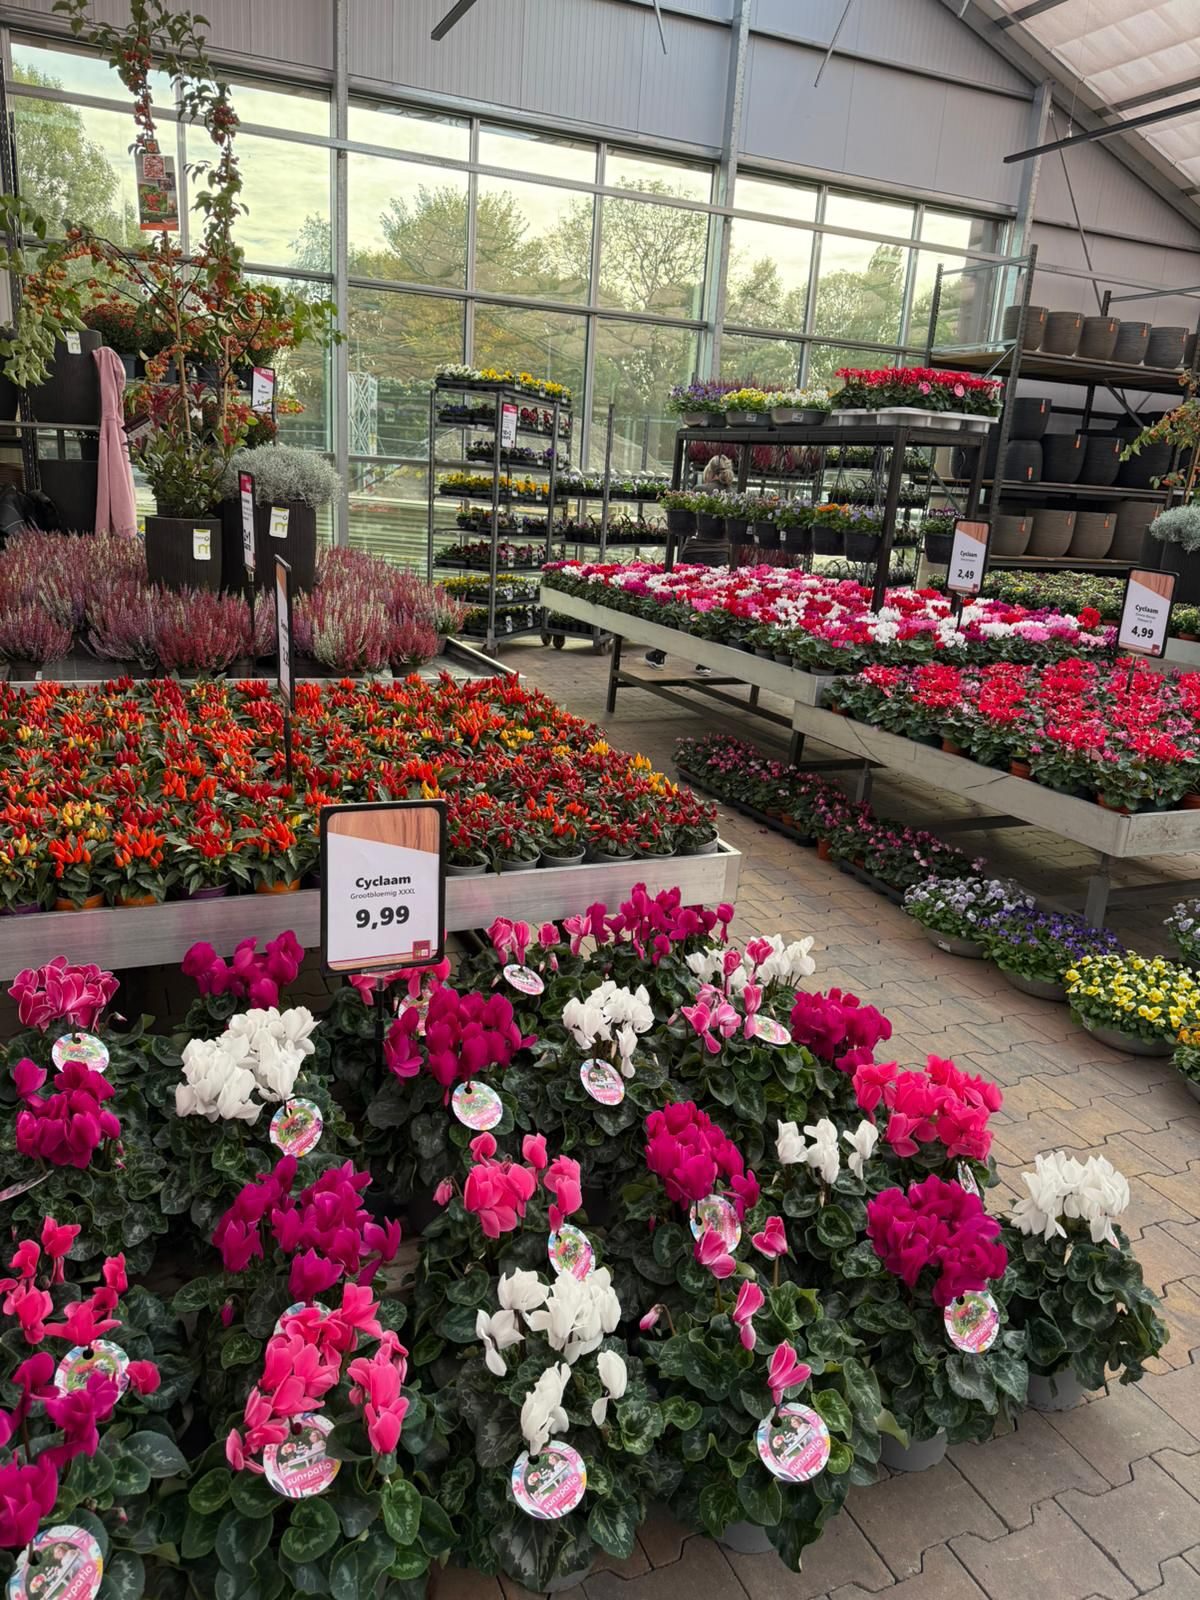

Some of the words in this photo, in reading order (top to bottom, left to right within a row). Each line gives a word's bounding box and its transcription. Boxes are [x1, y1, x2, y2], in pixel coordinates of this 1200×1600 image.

[960, 550, 978, 558] Cyclaam
[957, 569, 975, 579] 2,49
[1135, 604, 1159, 614] Cyclaam
[1131, 626, 1154, 639] 4,99
[355, 875, 412, 890] Cyclaam
[350, 889, 398, 900] Grootbloemig
[398, 888, 416, 896] XXXL
[355, 905, 410, 930] 9,99
